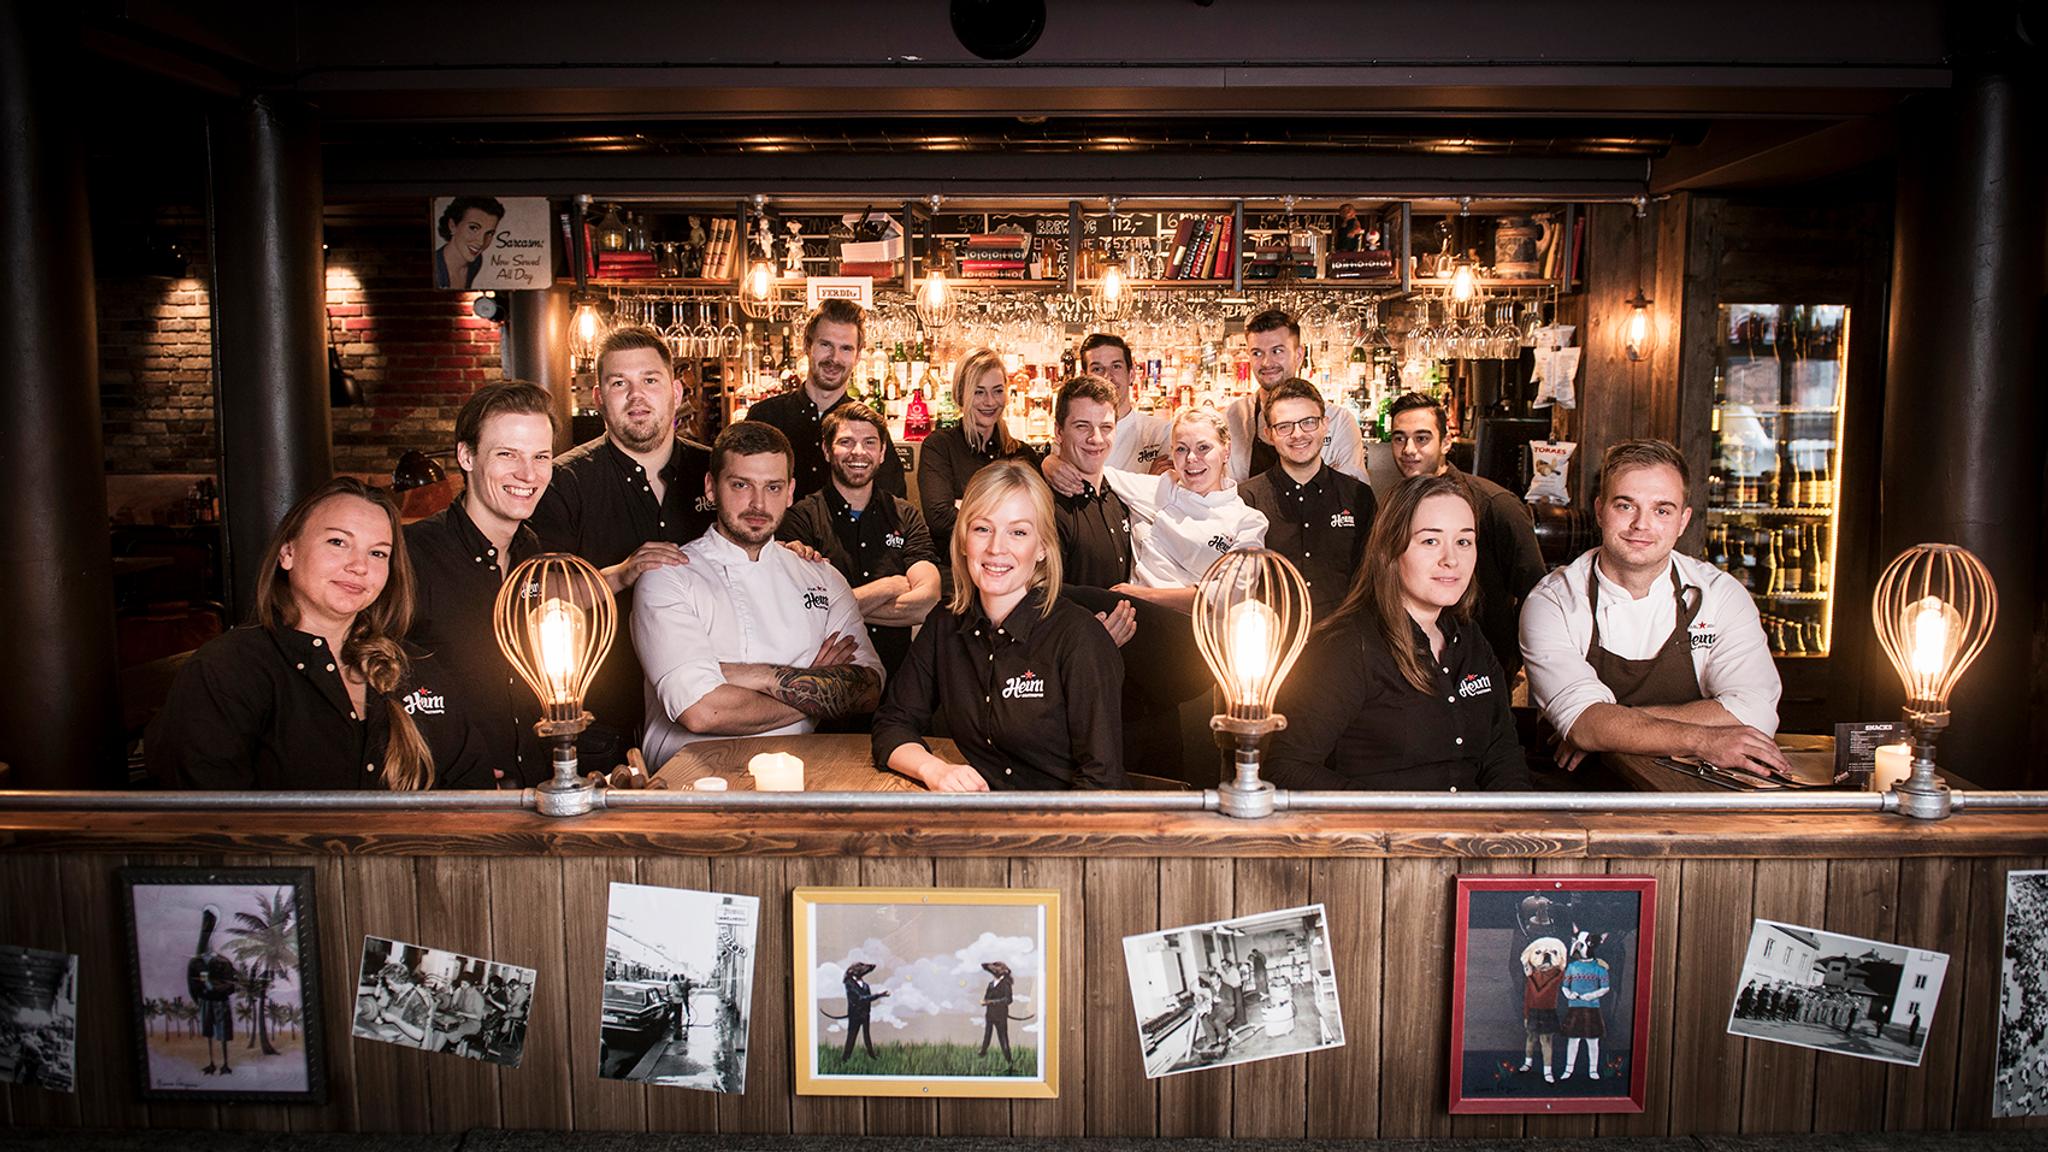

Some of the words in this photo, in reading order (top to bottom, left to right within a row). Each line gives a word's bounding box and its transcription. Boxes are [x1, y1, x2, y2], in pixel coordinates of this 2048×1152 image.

[496, 231, 544, 249] Sarcasm:
[491, 255, 509, 266] Now
[513, 254, 541, 266] Served
[497, 268, 513, 280] All
[515, 268, 534, 285] Day
[1002, 677, 1044, 699] Heim
